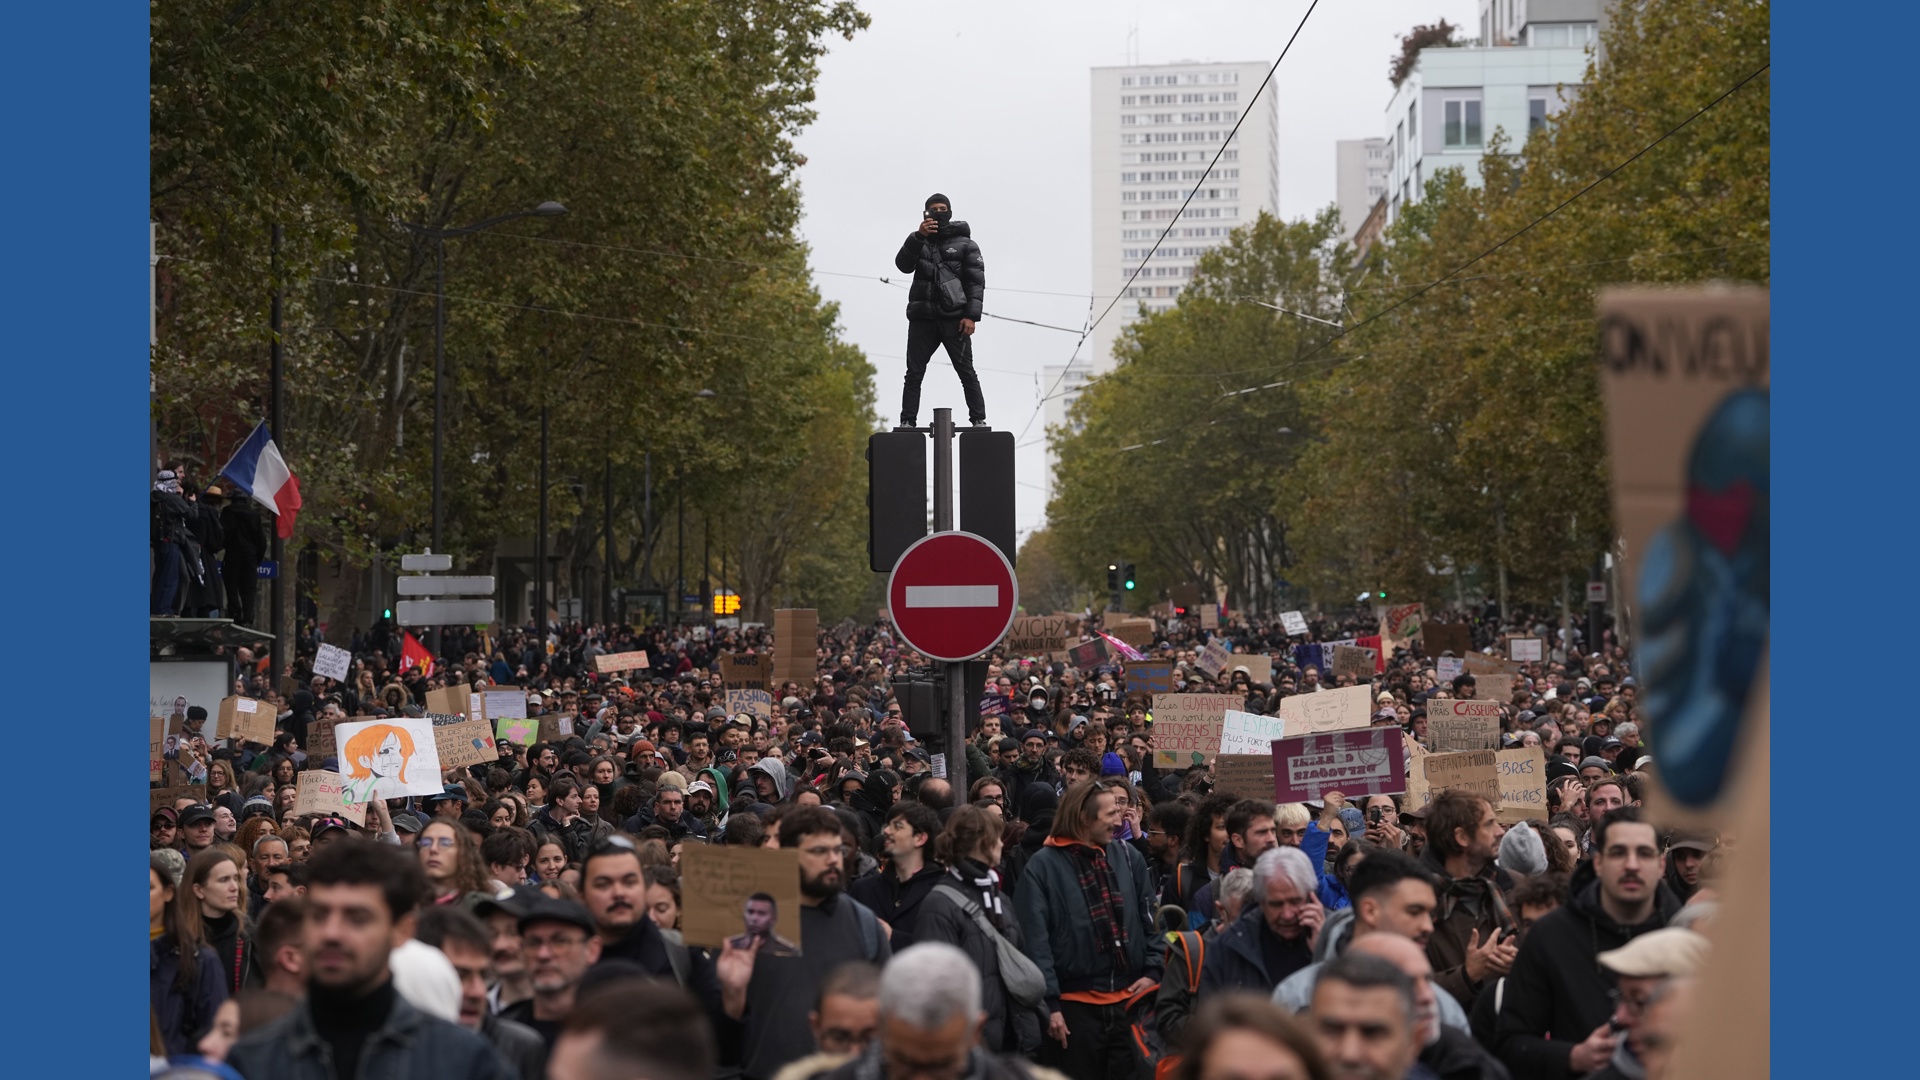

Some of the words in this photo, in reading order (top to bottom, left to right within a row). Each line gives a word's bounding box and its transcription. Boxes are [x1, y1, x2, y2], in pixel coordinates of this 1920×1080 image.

[1012, 619, 1064, 638] VICHY
[1010, 639, 1029, 651] DANS
[1030, 638, 1043, 651] LEUR
[1045, 637, 1066, 649] FROC
[733, 655, 759, 666] NOUS
[728, 690, 771, 706] FASHION
[1155, 695, 1178, 711] Les
[1182, 697, 1243, 712] GUYANAIS
[733, 701, 757, 713] PAS
[1428, 707, 1450, 716] VRAIS
[1453, 701, 1500, 717] CASSEURS
[1162, 714, 1177, 722] ne
[1180, 713, 1205, 722] sont
[1153, 722, 1210, 737] CITOYENS
[1226, 713, 1283, 738] L'ESPOIR
[436, 742, 455, 751] HIER
[1152, 736, 1200, 750] SECONDE
[1223, 732, 1244, 743] PLUS
[1247, 737, 1264, 747] FORT
[437, 747, 470, 758] RANÇAIS
[449, 756, 460, 765] 10
[461, 752, 479, 762] ANS
[1429, 755, 1467, 773] ENFANTS
[1497, 759, 1535, 776] EBRES
[1293, 764, 1376, 781] DELACQUIS
